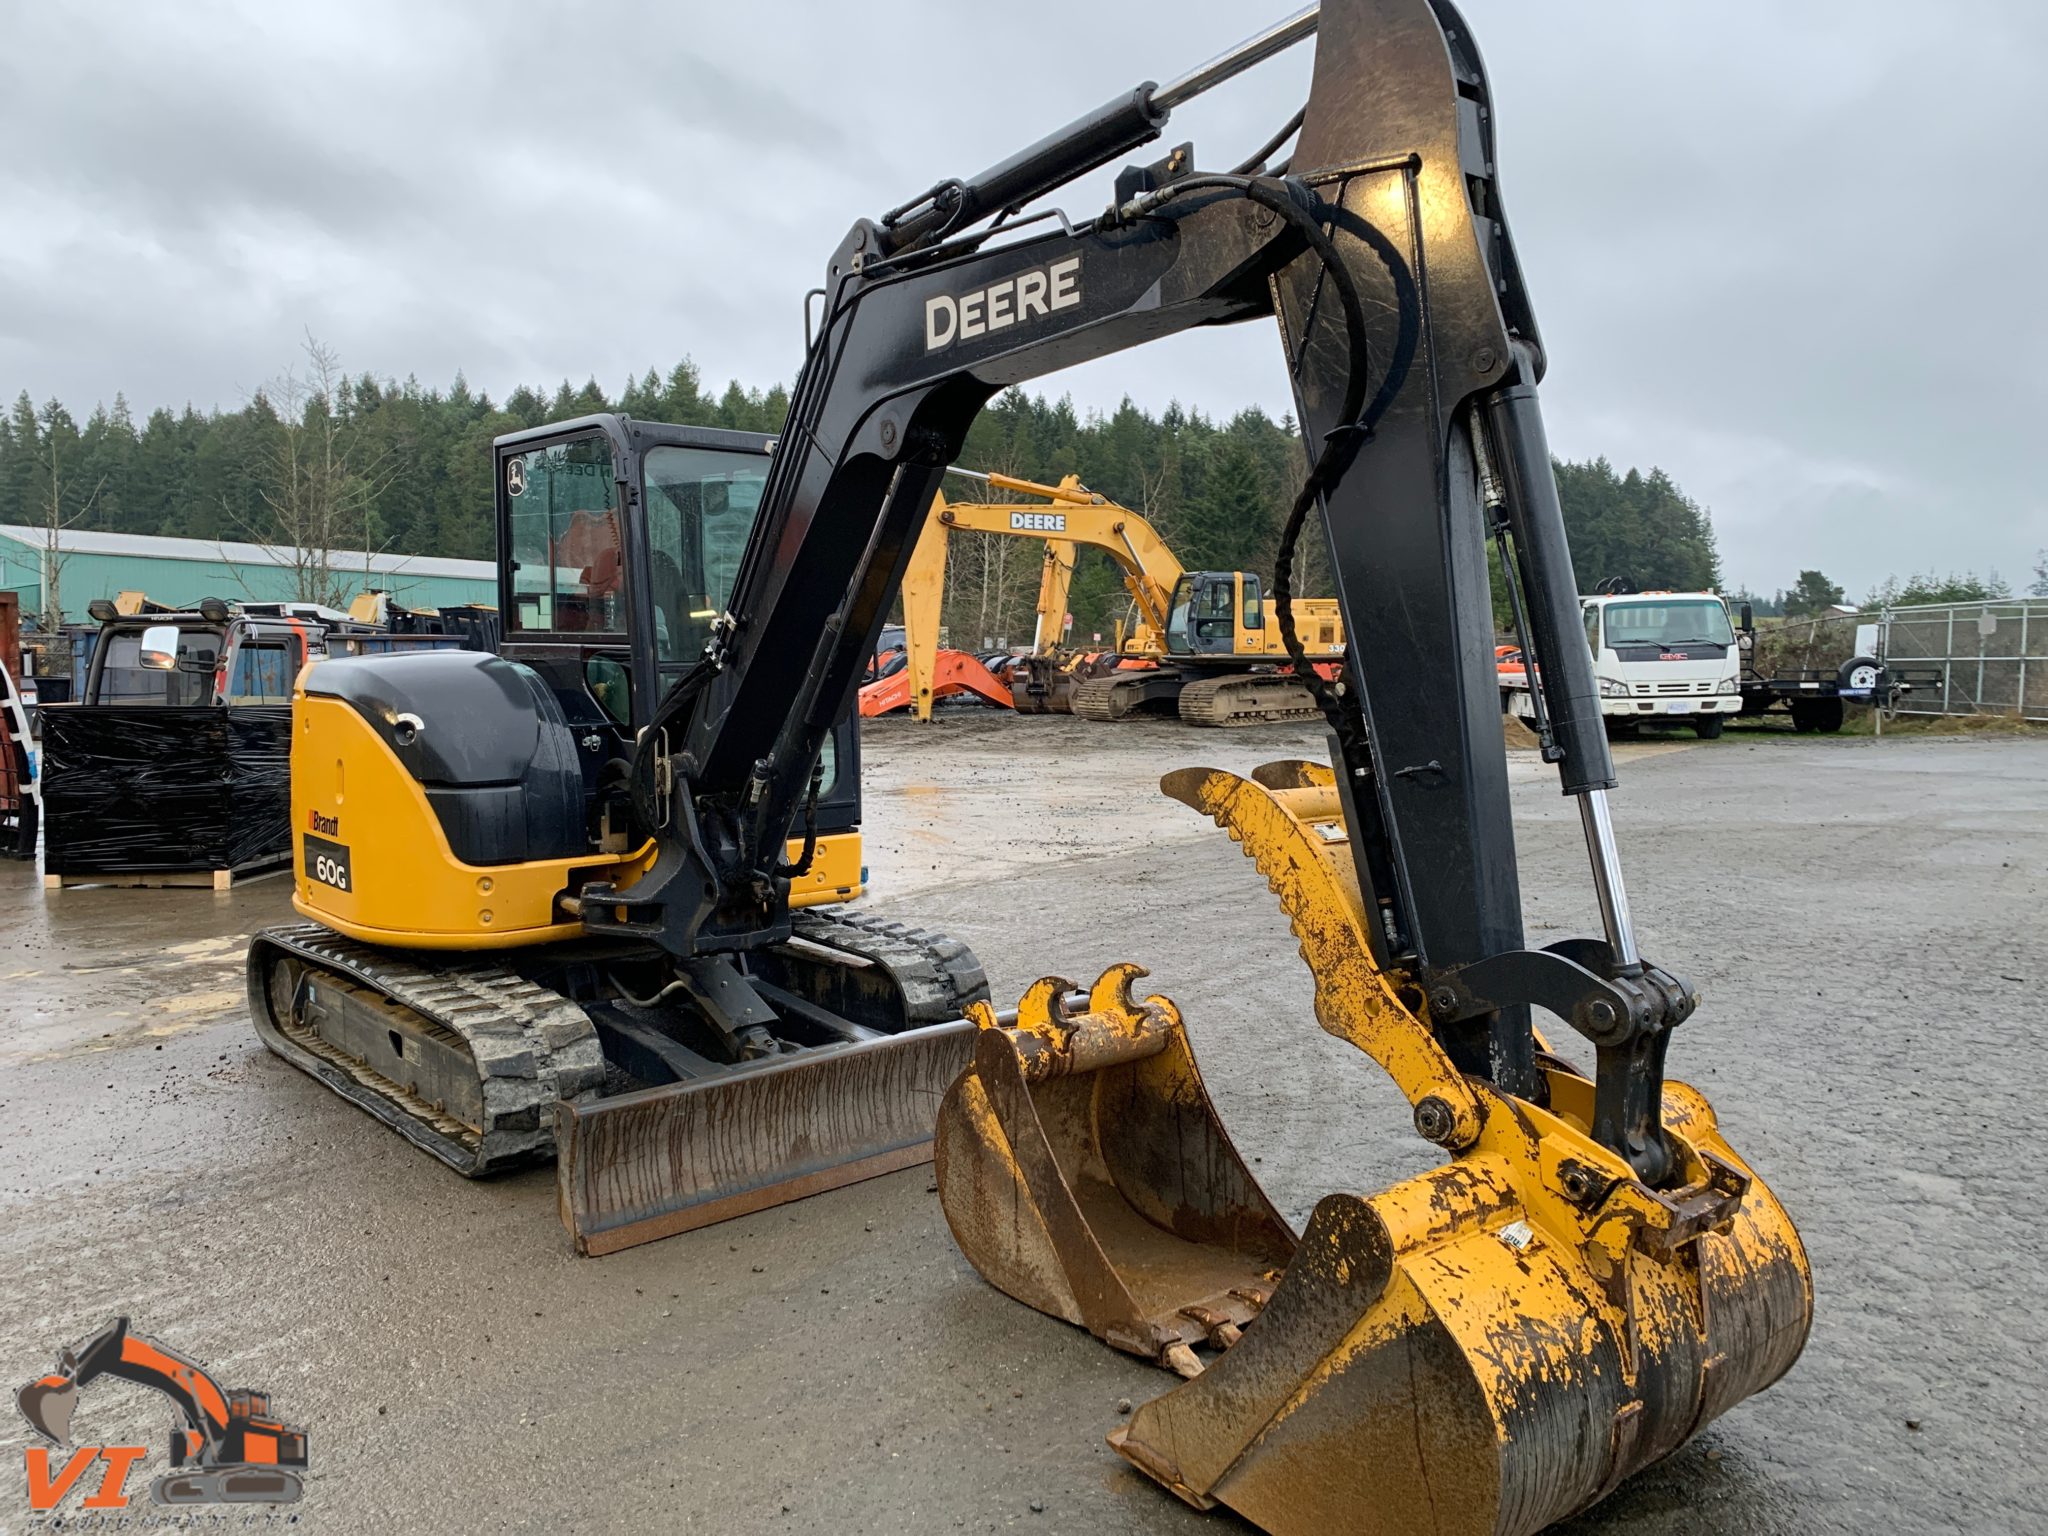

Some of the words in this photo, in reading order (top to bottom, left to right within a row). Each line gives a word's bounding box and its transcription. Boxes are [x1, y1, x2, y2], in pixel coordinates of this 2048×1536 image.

[925, 257, 1081, 351] DEERE
[1011, 512, 1066, 531] DEERE
[1328, 644, 1346, 652] 330
[1659, 652, 1688, 660] GMC
[879, 691, 902, 707] HITACHI
[313, 810, 339, 837] Brandt
[316, 855, 346, 889] 60G
